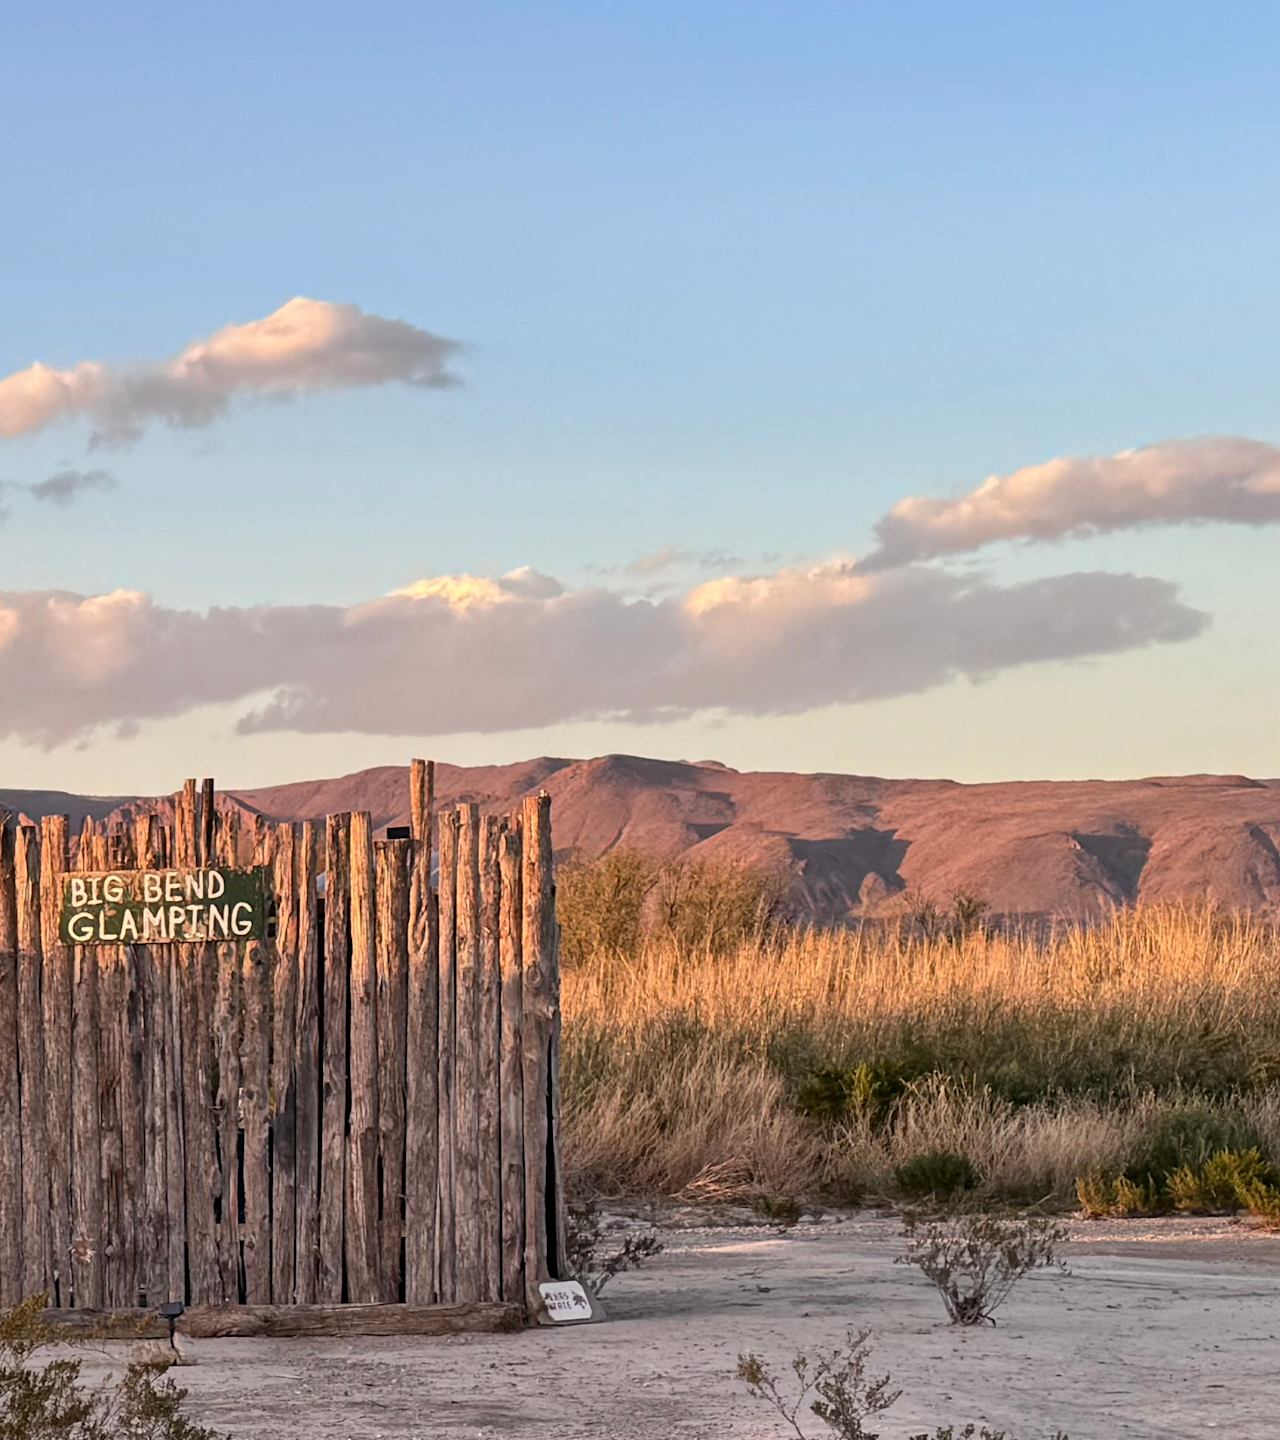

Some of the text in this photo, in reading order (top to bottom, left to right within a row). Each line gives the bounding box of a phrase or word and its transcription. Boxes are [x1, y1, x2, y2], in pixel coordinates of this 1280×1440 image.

[71, 870, 225, 907] BIG BEND
[68, 902, 252, 942] GLAMPING
